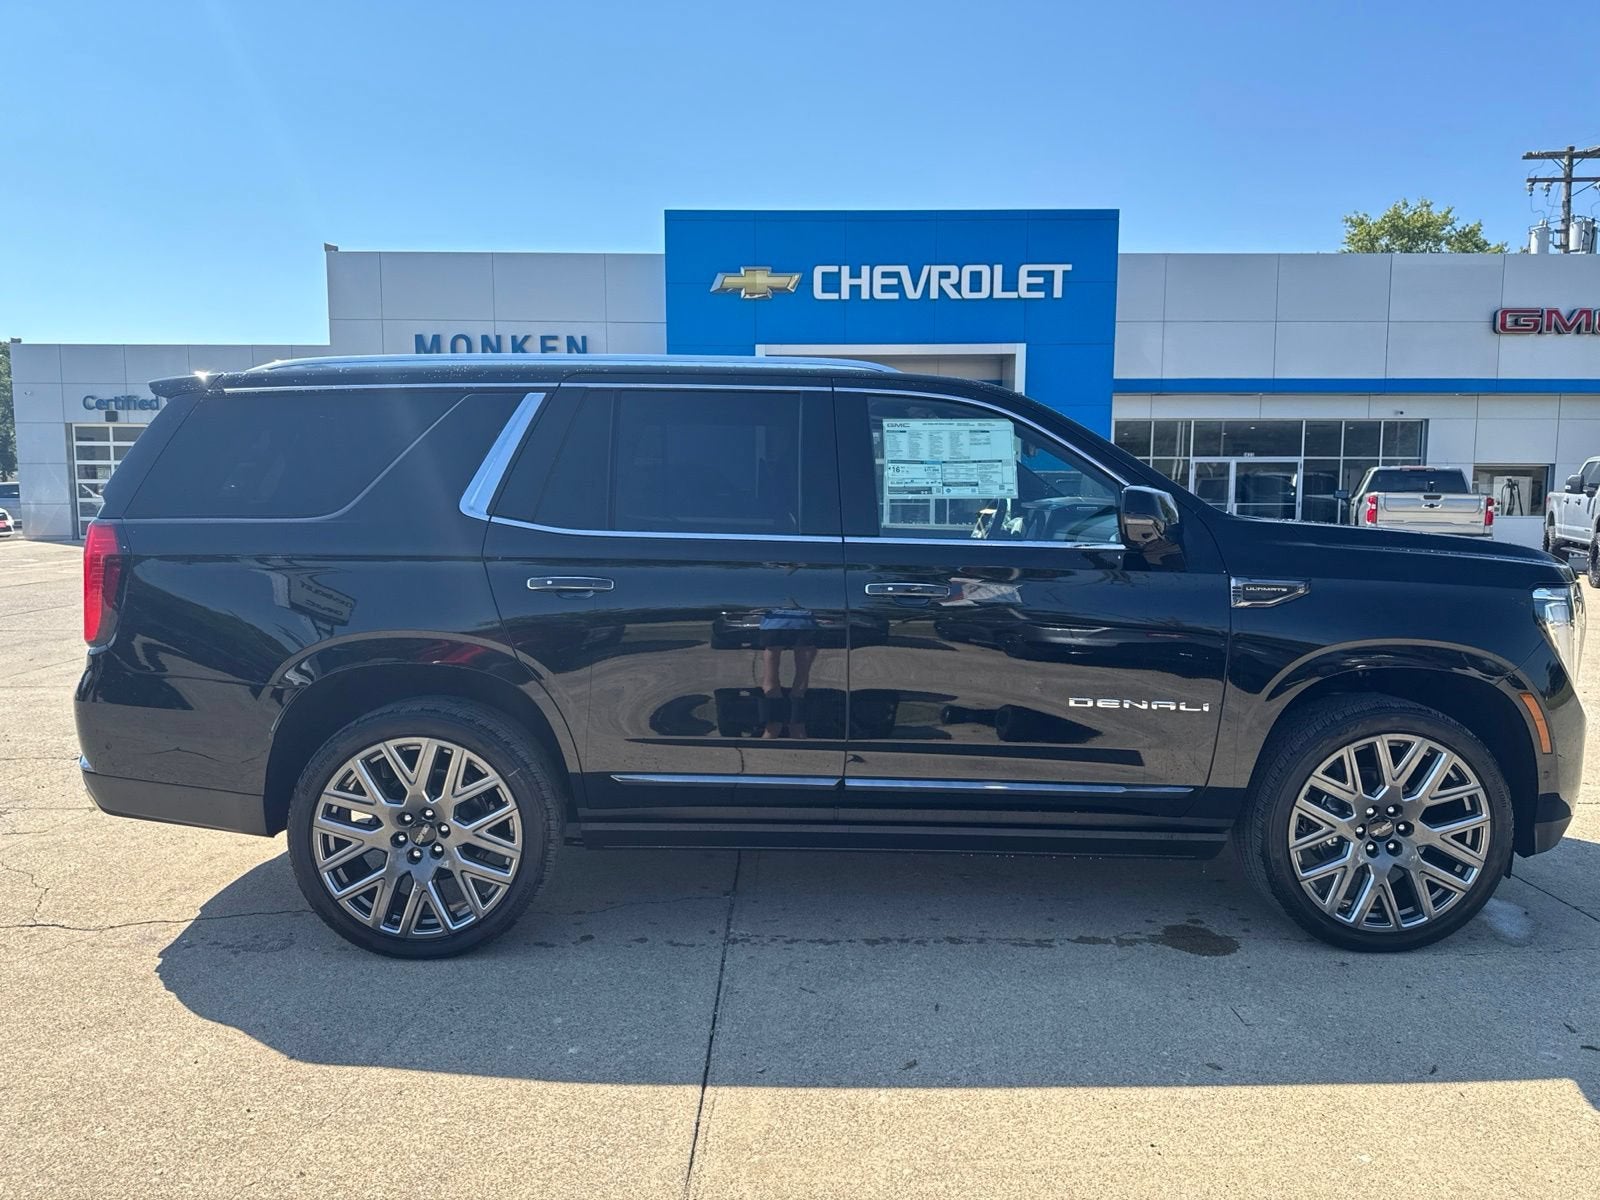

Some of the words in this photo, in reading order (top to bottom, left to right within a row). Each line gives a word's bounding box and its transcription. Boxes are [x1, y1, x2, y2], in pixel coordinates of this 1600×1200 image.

[813, 263, 1073, 300] CHEVROLET
[1493, 308, 1600, 335] GM
[414, 333, 588, 354] MONKEN
[83, 395, 160, 411] Certified
[1068, 697, 1210, 712] DENALI
